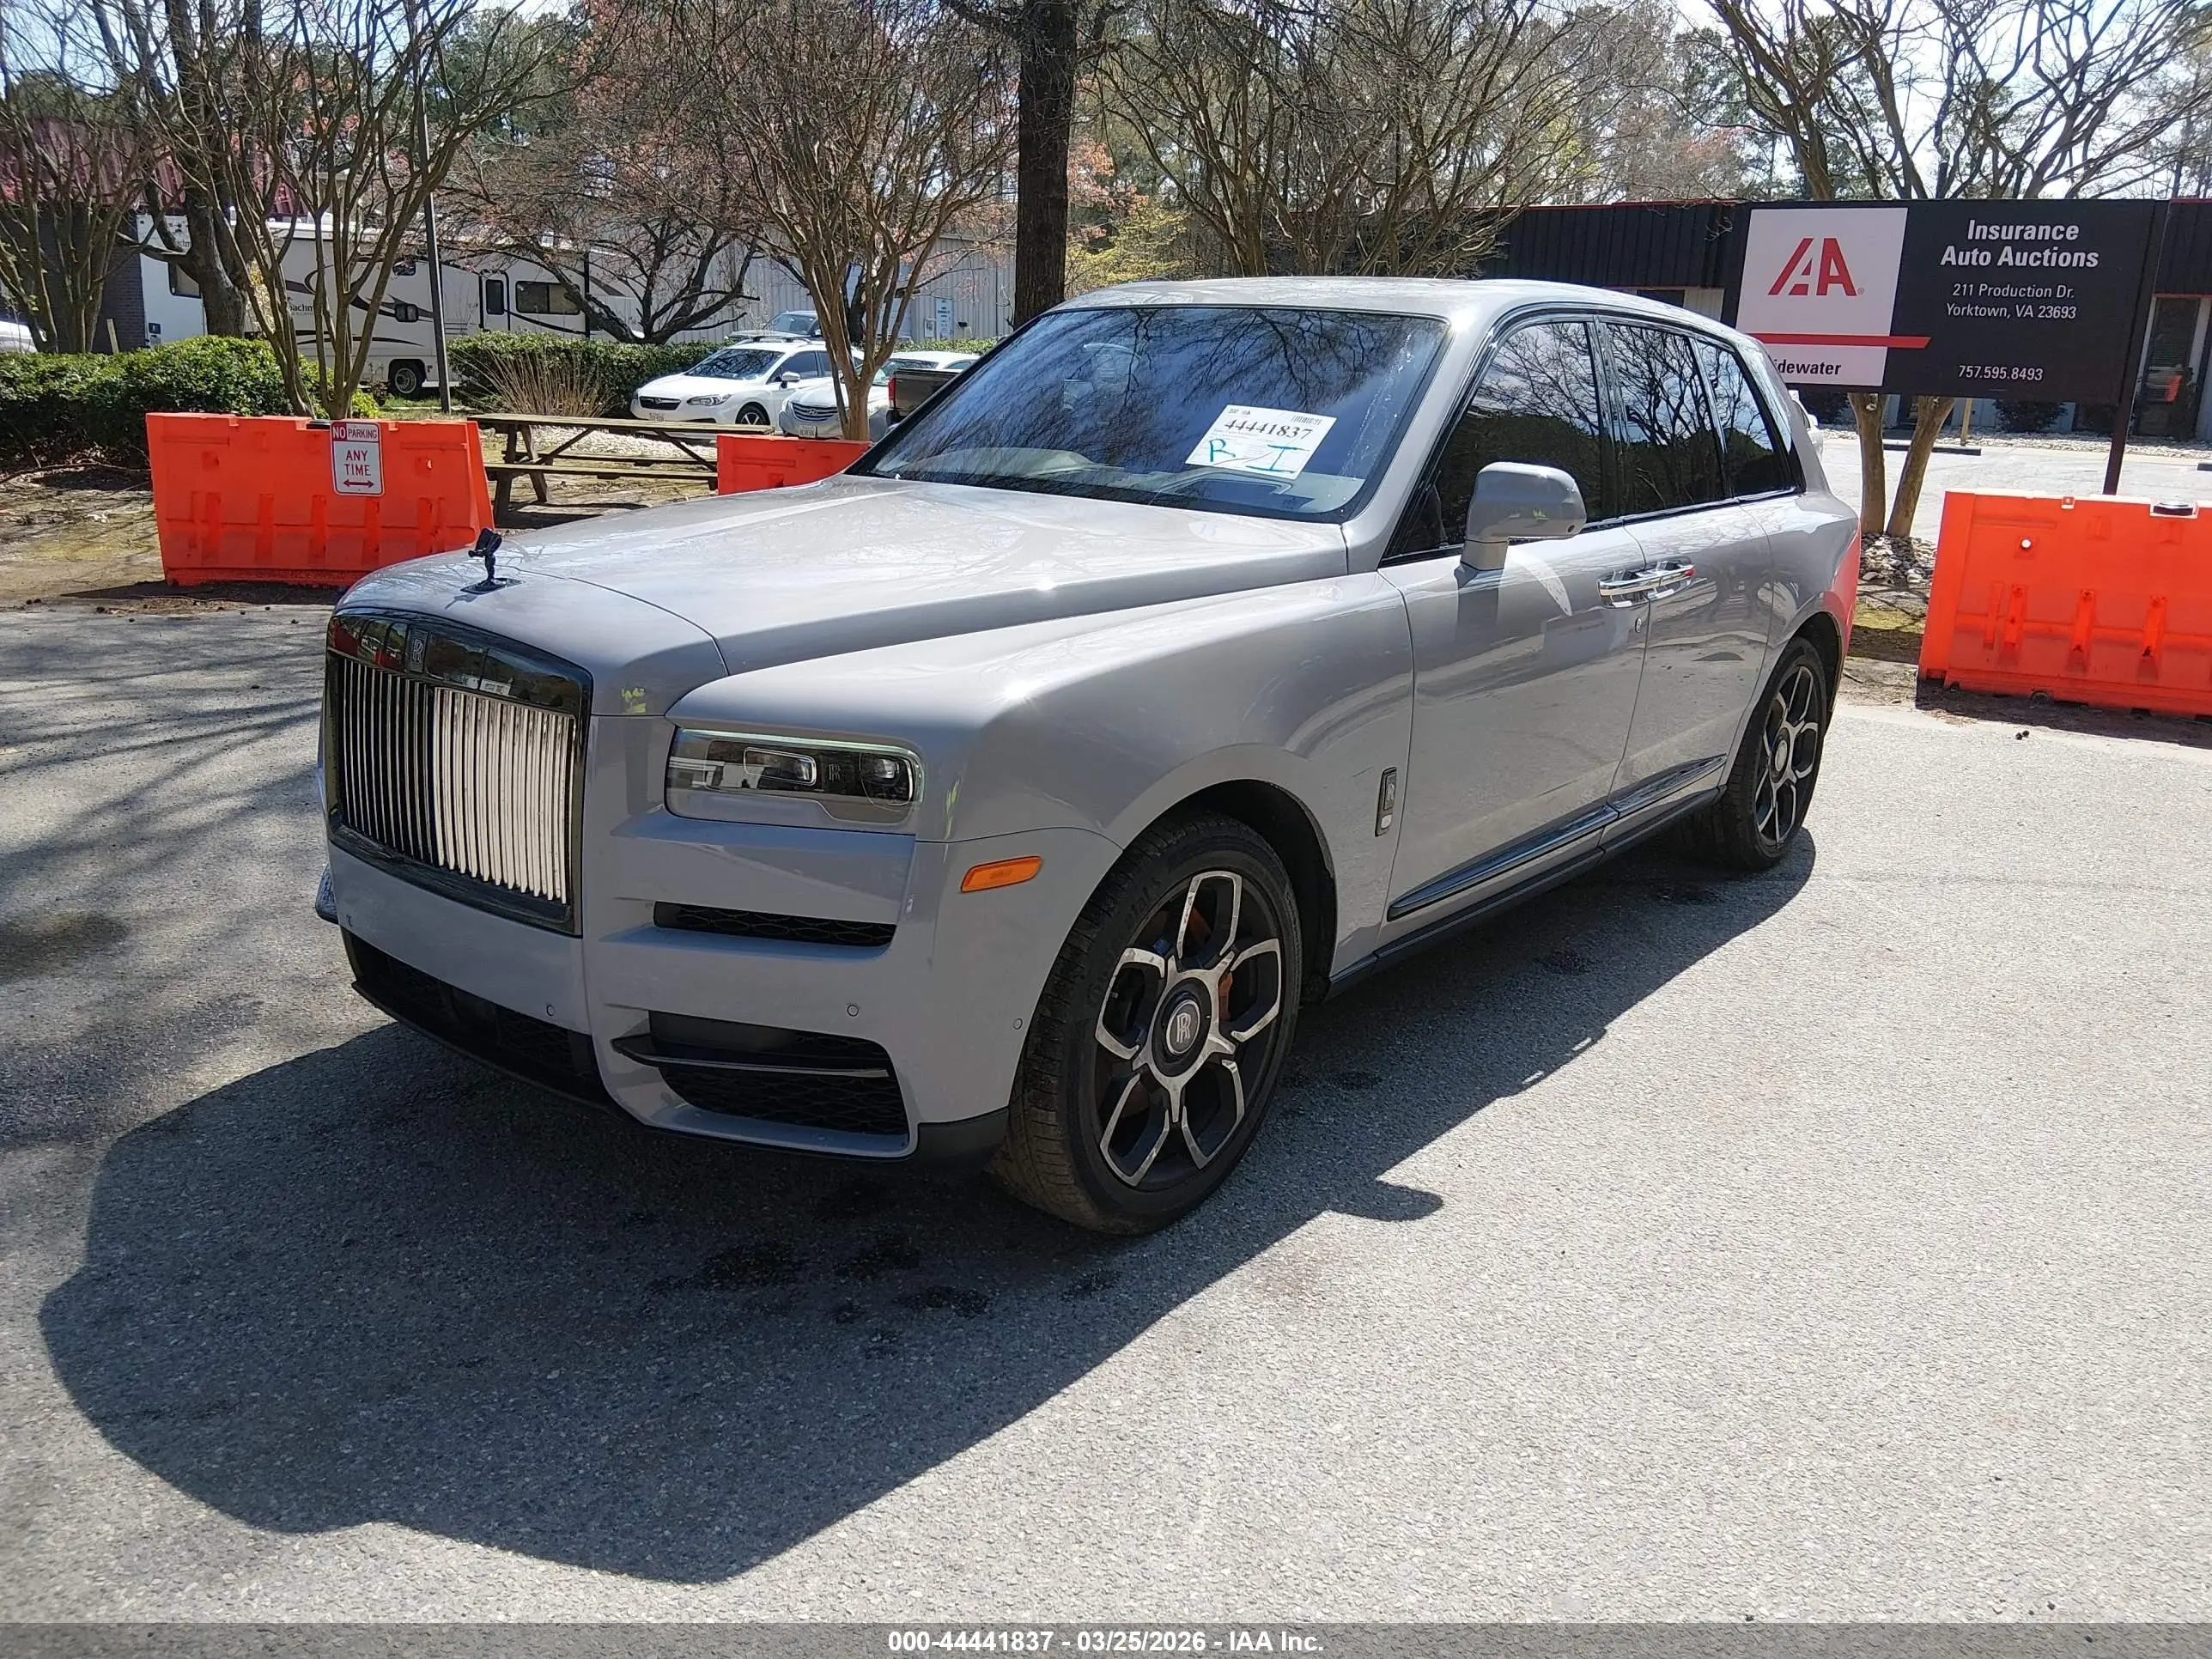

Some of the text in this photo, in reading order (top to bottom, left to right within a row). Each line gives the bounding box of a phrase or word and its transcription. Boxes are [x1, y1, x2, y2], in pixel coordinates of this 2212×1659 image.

[1967, 219, 2080, 240] Insurance
[1940, 246, 2100, 268] Auto Auctions
[1952, 283, 2075, 298] 211 Production Dr.
[1946, 303, 2076, 319] Yorktown, VA 23693
[1773, 359, 1842, 375] idewater
[1959, 365, 2044, 381] 757.595.8493
[332, 426, 378, 439] NO PARKING
[1224, 419, 1313, 440] 44441837
[345, 449, 368, 462] ANY
[343, 463, 371, 477] TIME
